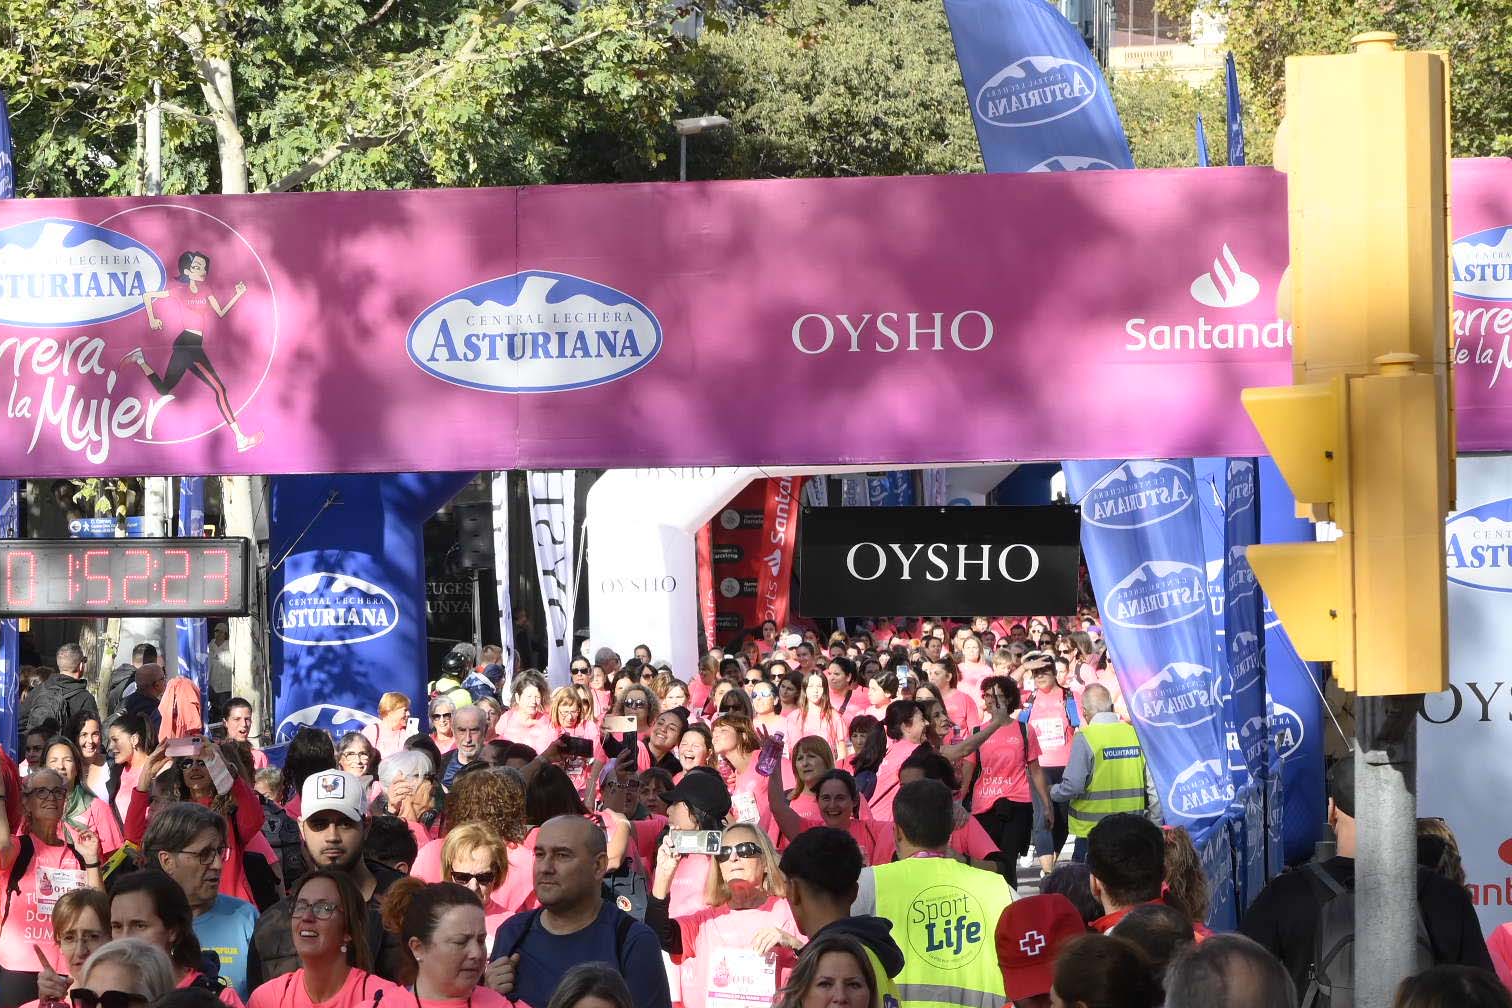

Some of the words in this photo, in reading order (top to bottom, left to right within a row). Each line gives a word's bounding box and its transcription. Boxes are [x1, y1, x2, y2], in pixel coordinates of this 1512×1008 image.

[66, 254, 142, 266] LECHERA
[464, 313, 544, 327] CENTRAL
[552, 311, 634, 325] LECHERA
[791, 310, 994, 355] OYSHO
[426, 317, 642, 363] ASTURIANA
[7, 376, 32, 419] la
[26, 369, 176, 465] Mujer
[7, 549, 231, 606] 01:52:23
[846, 540, 1040, 584] OYSHO
[288, 597, 334, 606] CENTRAL
[336, 596, 385, 606] LECHERA
[601, 576, 676, 592] OYSHO
[765, 580, 778, 621] orts
[276, 605, 389, 630] ASTURIANA
[1417, 682, 1512, 724] OY
[26, 911, 52, 922] DO
[913, 893, 971, 925] Sport
[925, 915, 981, 955] Life
